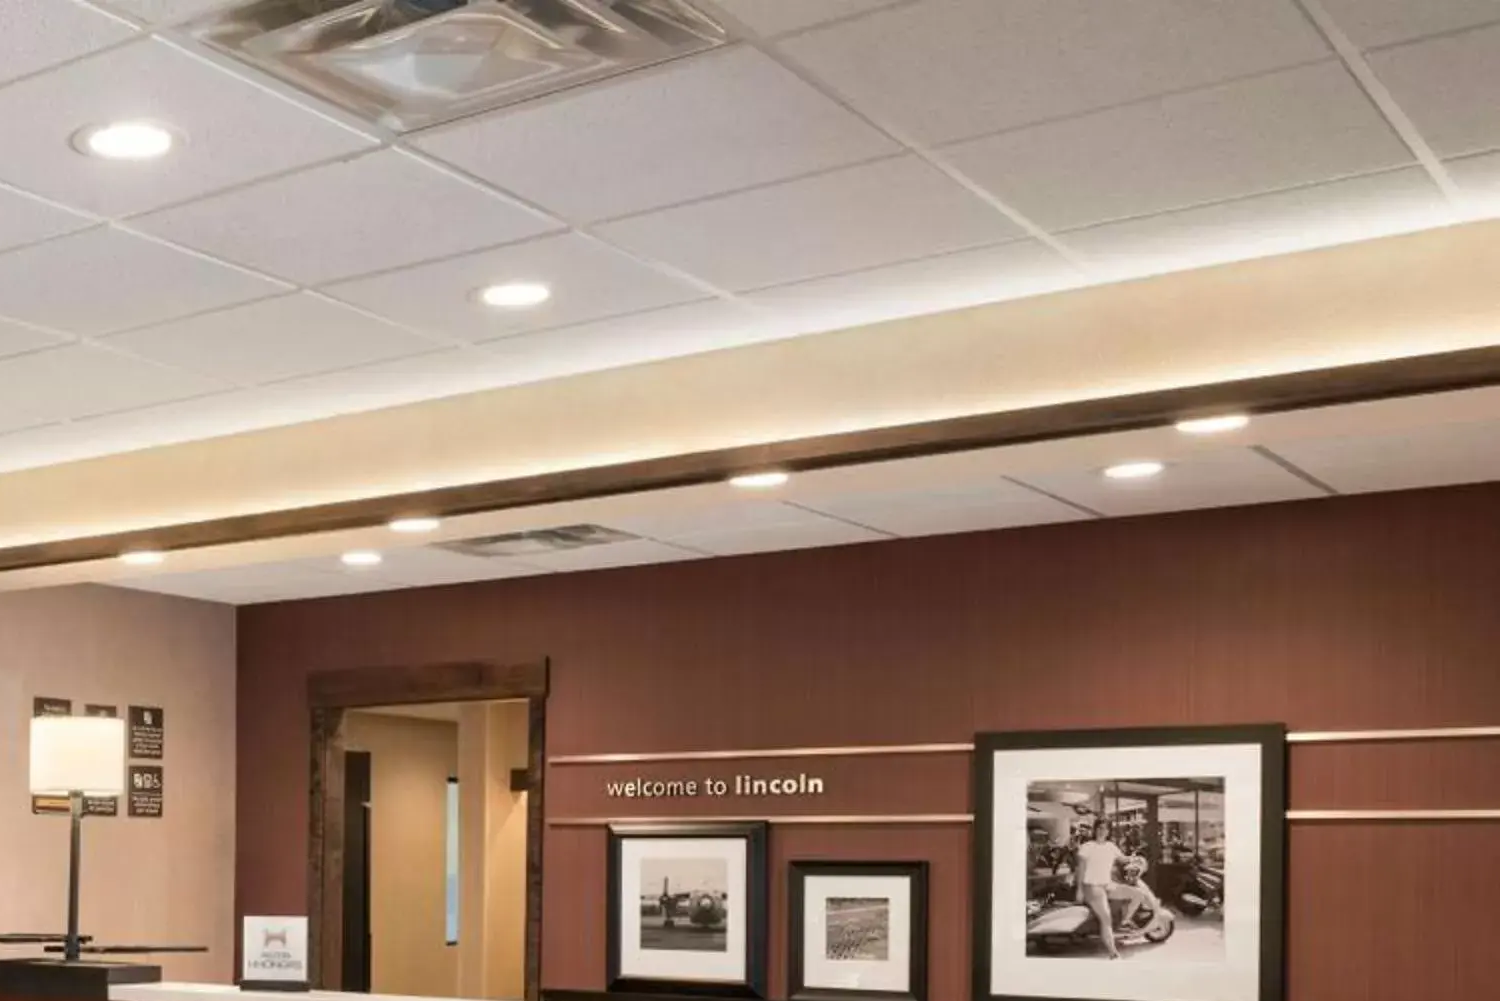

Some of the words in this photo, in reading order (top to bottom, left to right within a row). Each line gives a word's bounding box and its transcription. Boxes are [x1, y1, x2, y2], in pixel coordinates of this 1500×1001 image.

[606, 777, 697, 798] welcome
[704, 778, 727, 796] to
[734, 773, 824, 796] lincoln
